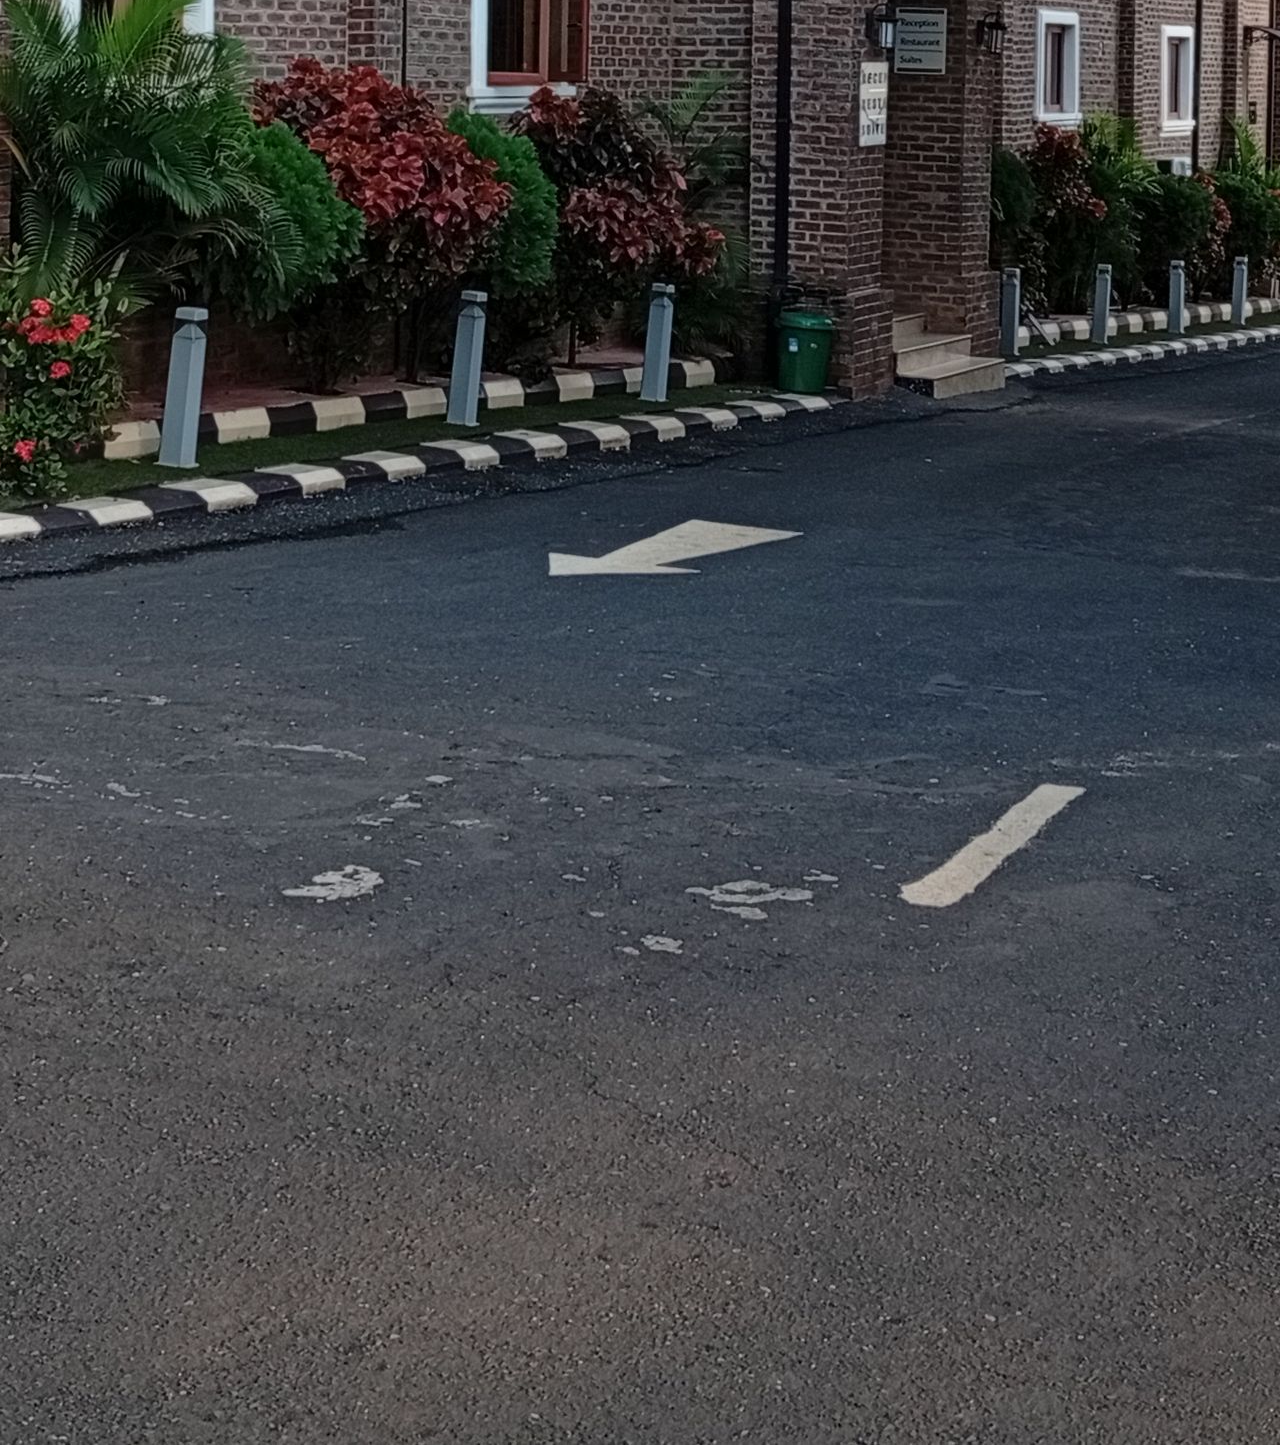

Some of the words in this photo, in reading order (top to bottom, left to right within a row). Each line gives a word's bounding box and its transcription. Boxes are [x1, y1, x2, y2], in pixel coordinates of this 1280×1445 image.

[900, 18, 939, 29] Reception
[900, 37, 940, 46] Restaurant
[899, 55, 923, 64] Suites
